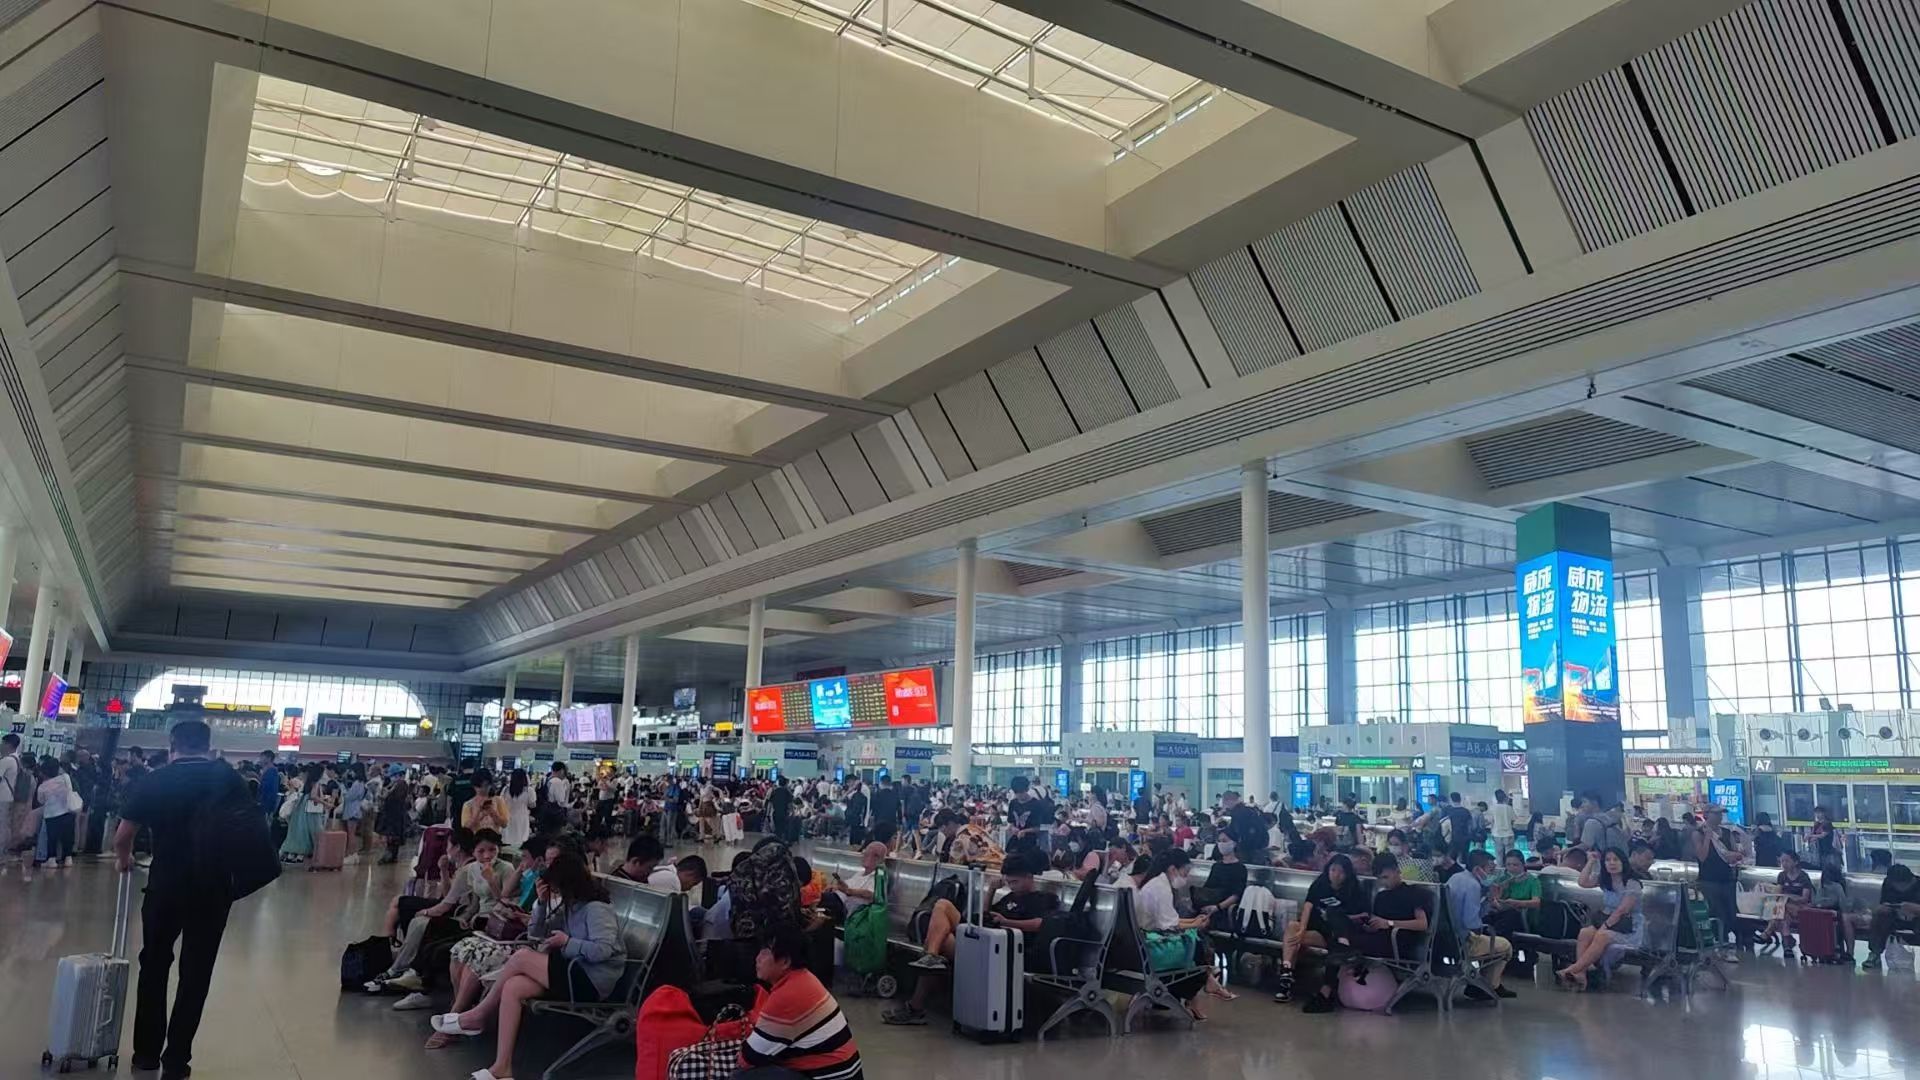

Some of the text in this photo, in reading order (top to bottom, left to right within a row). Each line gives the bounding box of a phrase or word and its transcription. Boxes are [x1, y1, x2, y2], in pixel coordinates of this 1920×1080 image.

[1523, 565, 1553, 595] 威成
[1567, 565, 1604, 593] 威成
[1526, 590, 1556, 618] 物流
[1570, 590, 1608, 618] 物流
[1755, 760, 1771, 772] A7
